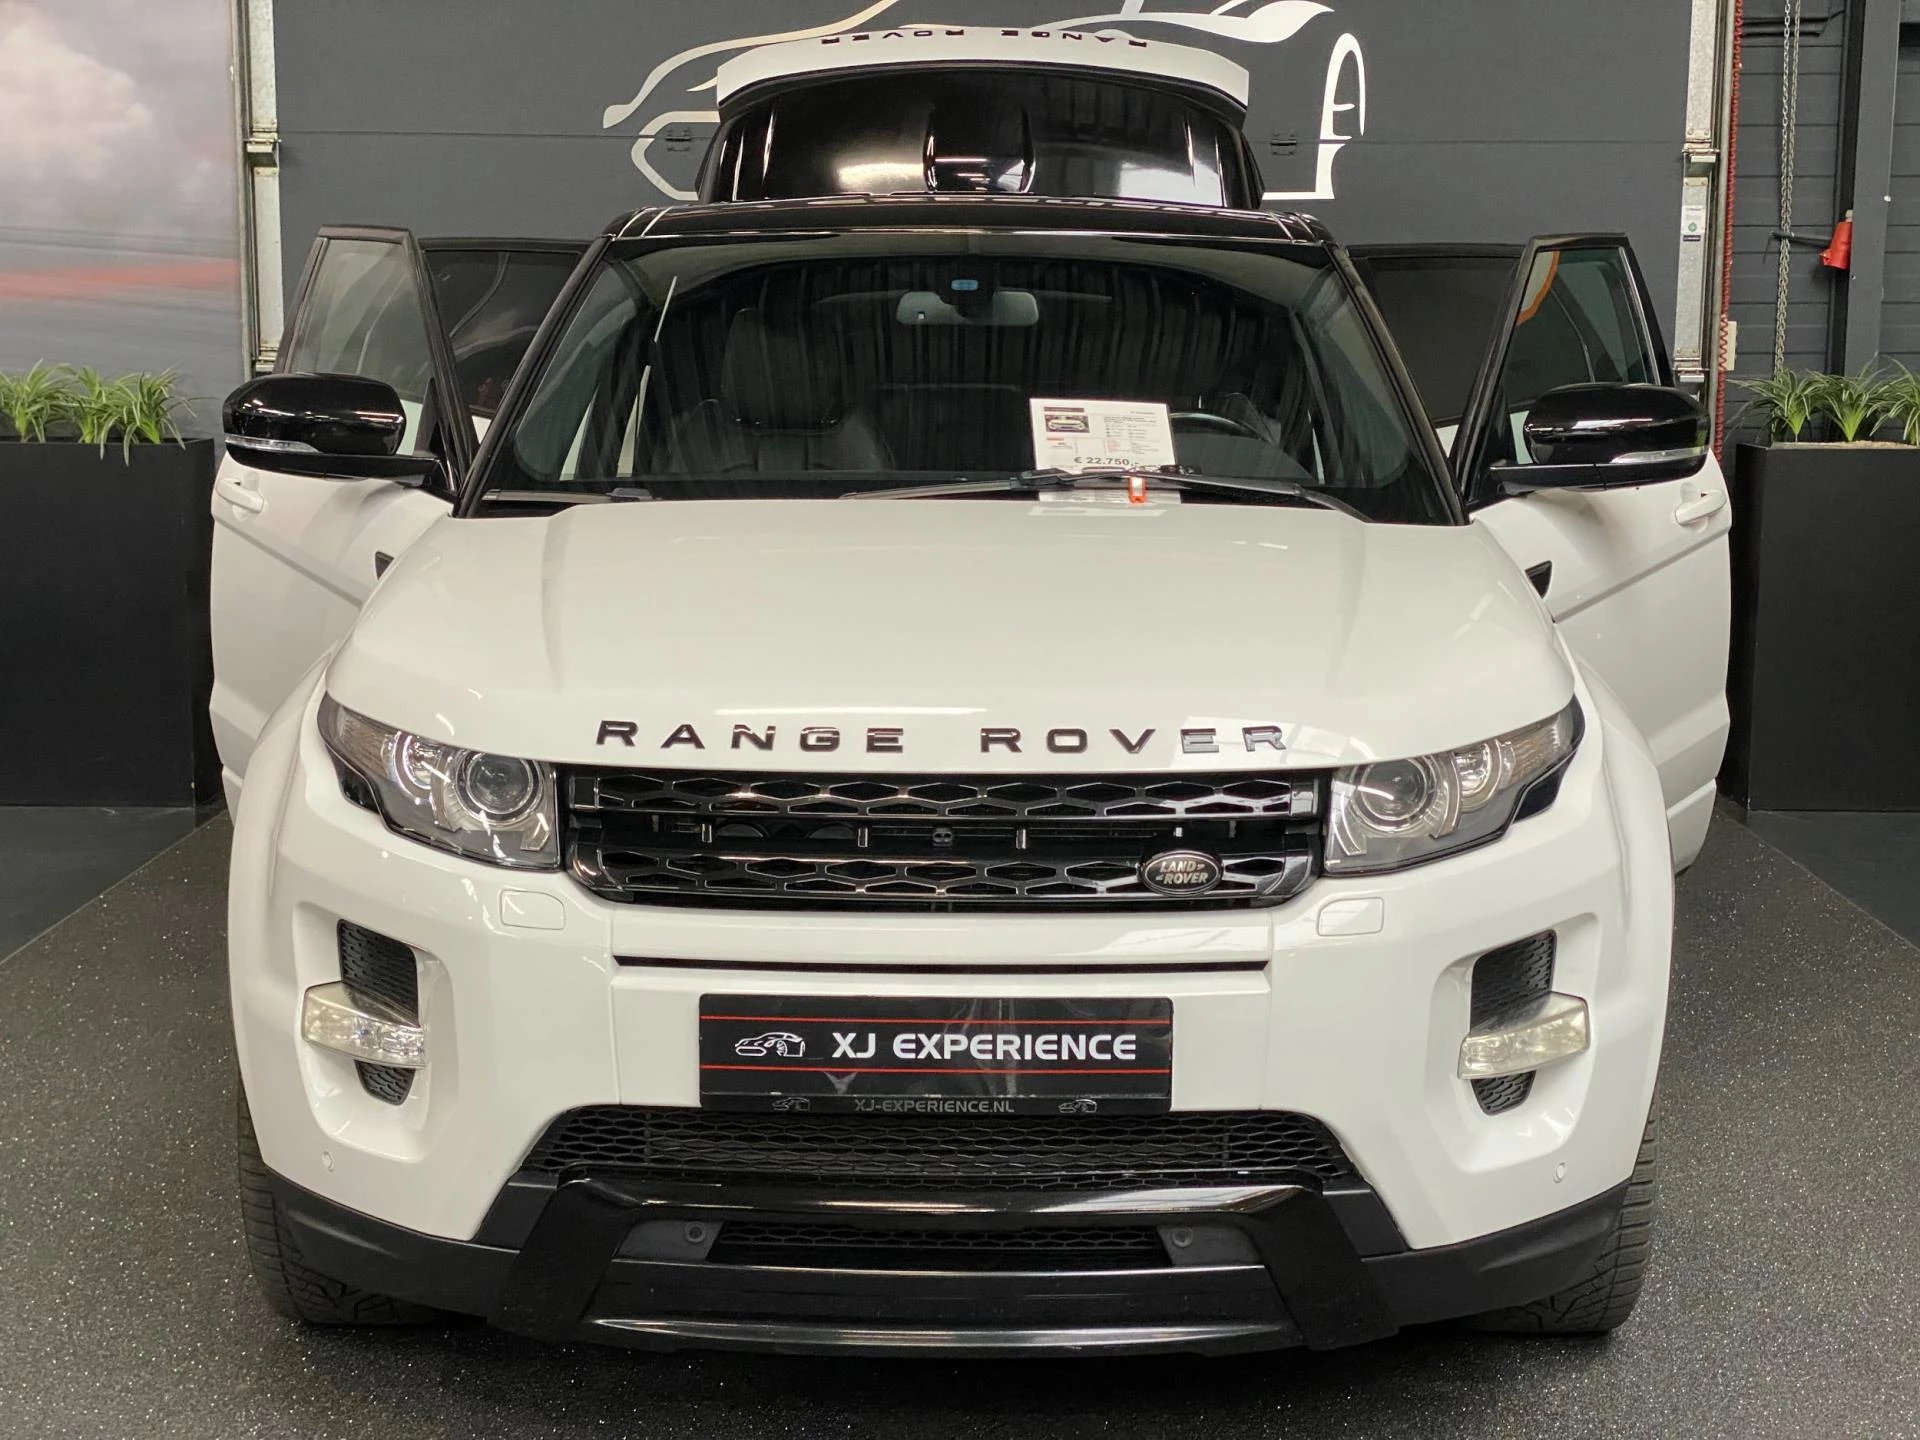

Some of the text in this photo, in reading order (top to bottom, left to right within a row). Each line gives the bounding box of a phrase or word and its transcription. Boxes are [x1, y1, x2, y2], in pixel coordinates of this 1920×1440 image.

[596, 719, 1287, 755] RANGE ROVER
[1160, 861, 1197, 872] LAND
[1163, 872, 1208, 884] ROVER
[831, 1032, 1137, 1061] XJ EXPERIENCE
[854, 1097, 1015, 1114] XJ-EXPERIENCE.NL
